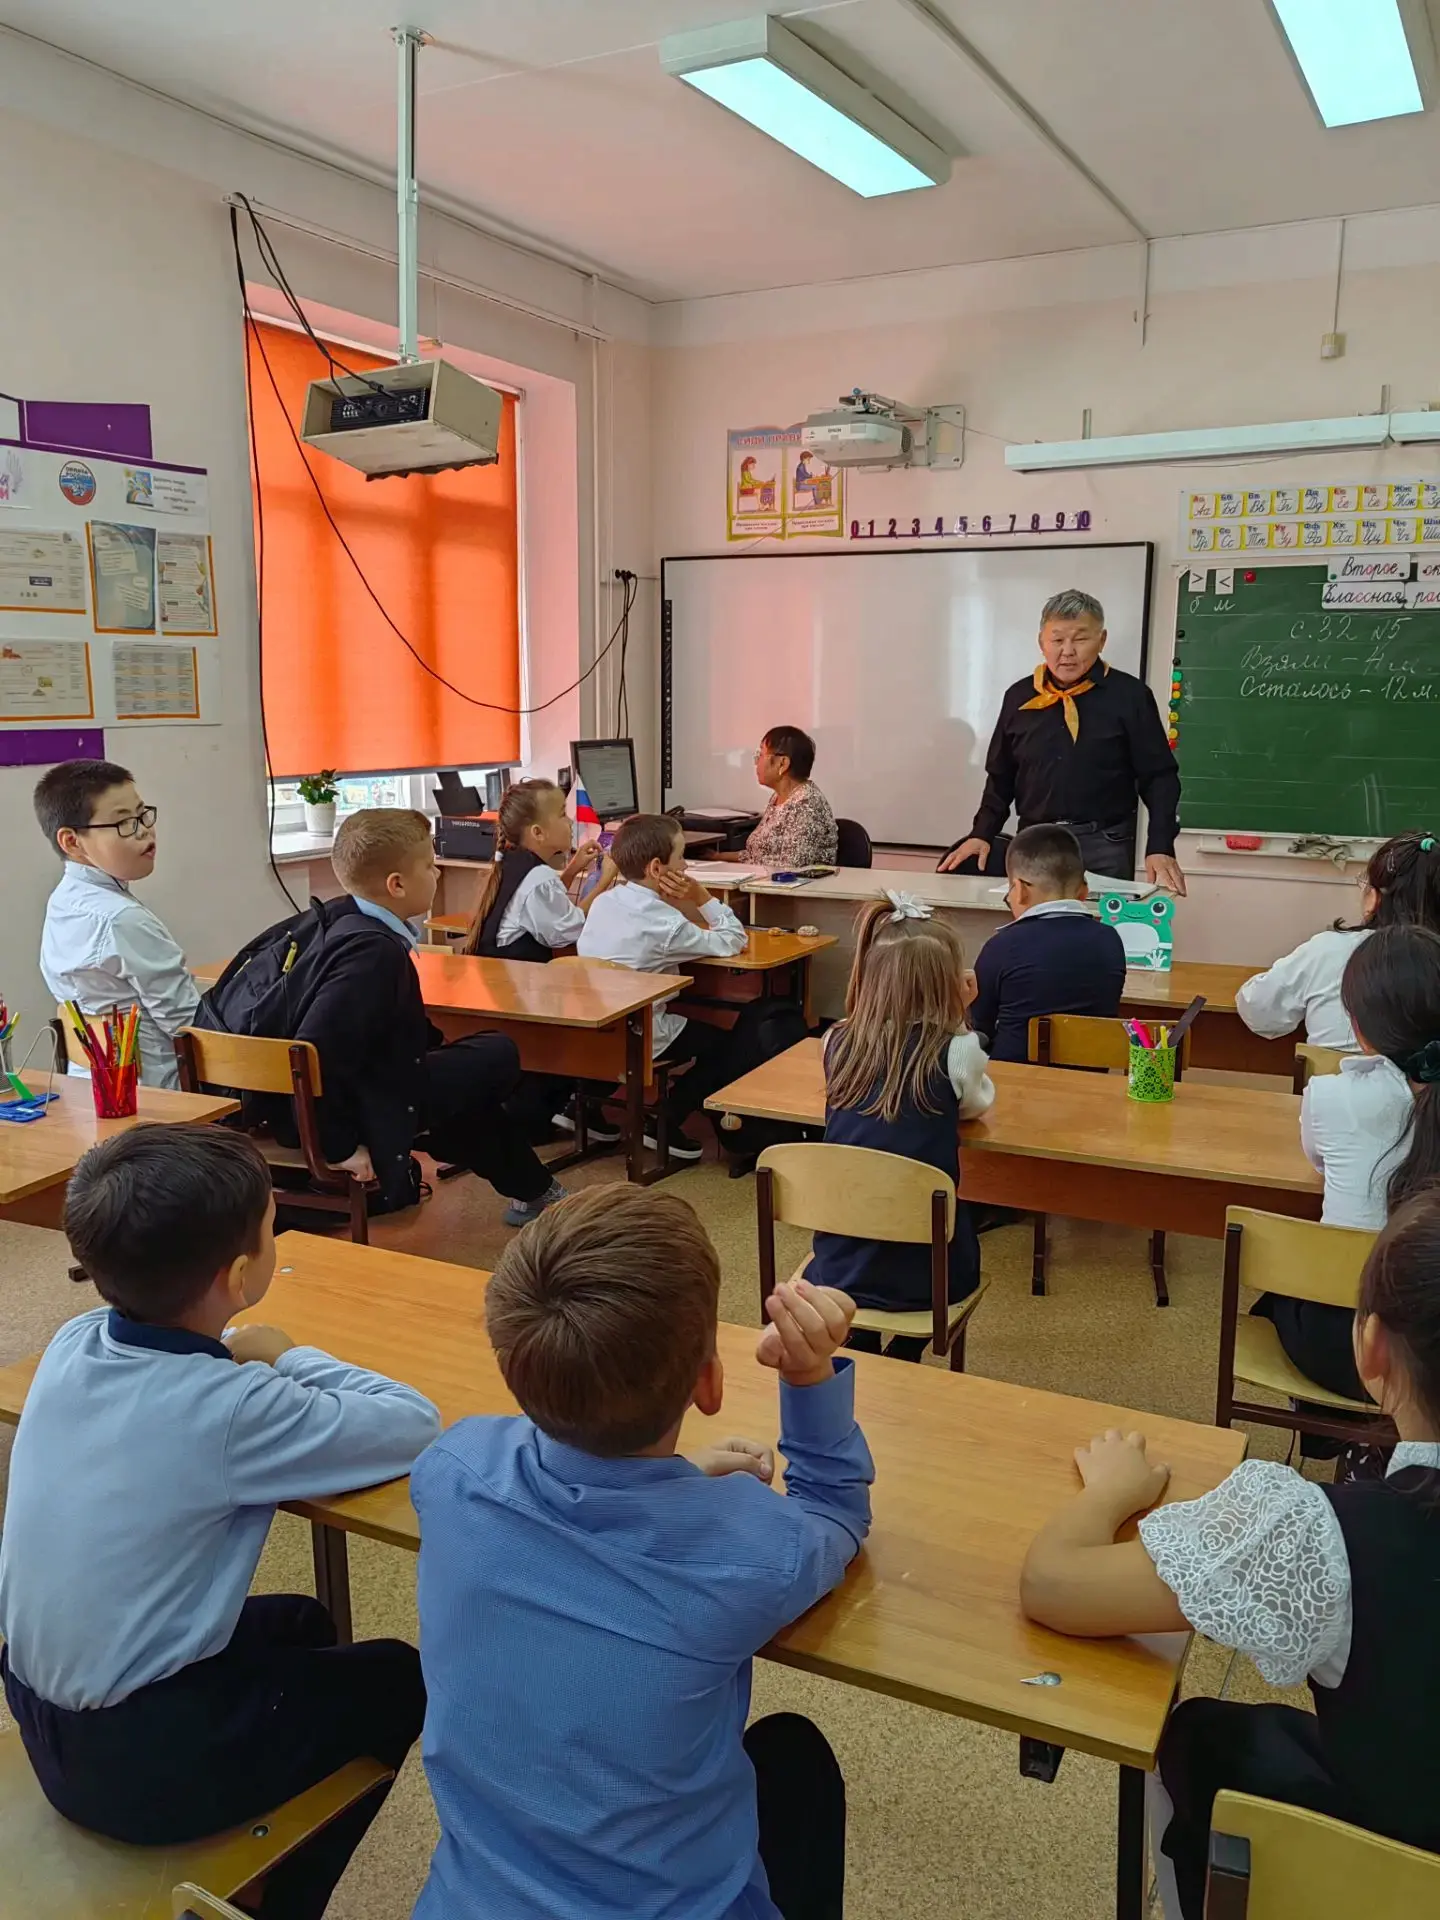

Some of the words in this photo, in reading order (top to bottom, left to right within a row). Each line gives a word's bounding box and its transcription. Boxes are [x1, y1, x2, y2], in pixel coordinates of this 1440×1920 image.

[851, 520, 859, 536] 0
[868, 519, 875, 536] 1
[889, 518, 897, 536] 2
[912, 518, 920, 535] 3
[935, 516, 943, 534] 4
[958, 516, 968, 532] 5
[982, 515, 991, 532] 6
[1009, 514, 1016, 532] 7
[1031, 513, 1040, 531] 8
[1056, 512, 1065, 529] 9
[1074, 510, 1090, 529] 10
[1341, 556, 1398, 580] Второе
[1323, 583, 1404, 603] Классная
[1240, 676, 1352, 700] Осталось
